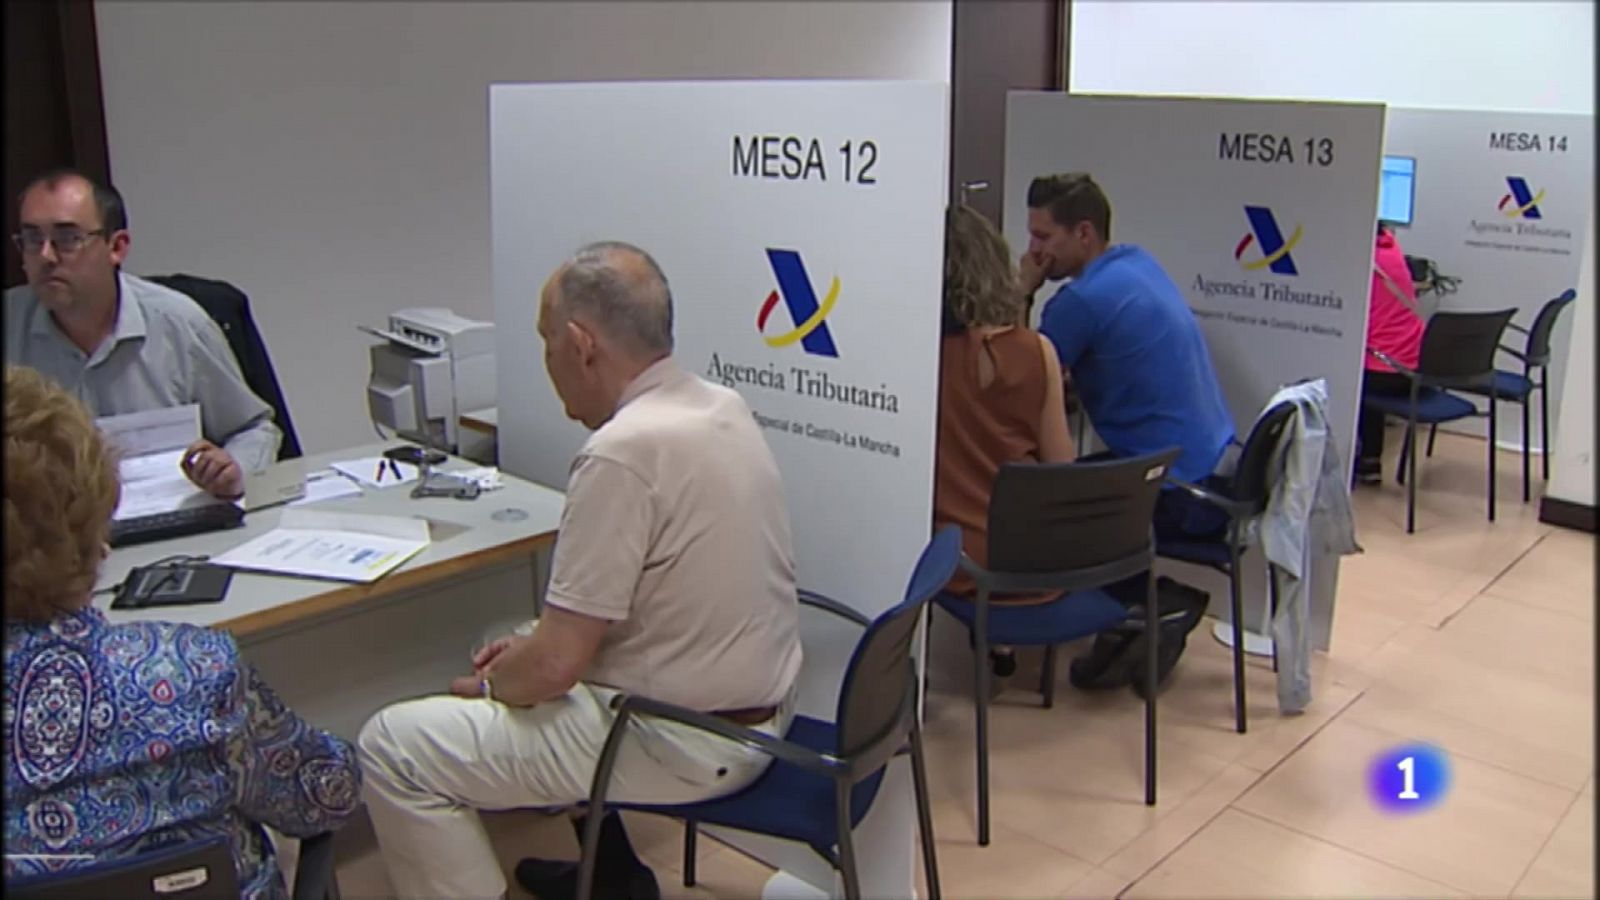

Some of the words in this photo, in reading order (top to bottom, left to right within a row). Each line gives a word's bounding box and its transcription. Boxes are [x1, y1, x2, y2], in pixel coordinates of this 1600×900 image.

[732, 135, 826, 181] MESA
[839, 139, 878, 185] 12
[1218, 132, 1294, 164] MESA
[1304, 137, 1334, 167] 13
[1489, 132, 1541, 151] MESA
[1548, 135, 1568, 152] 14
[1192, 273, 1256, 298] Agencia
[1259, 281, 1343, 310] Tributaria
[706, 352, 785, 388] Agencia
[790, 366, 899, 414] Tributaria
[791, 422, 803, 435] de
[859, 434, 900, 458] Mancha
